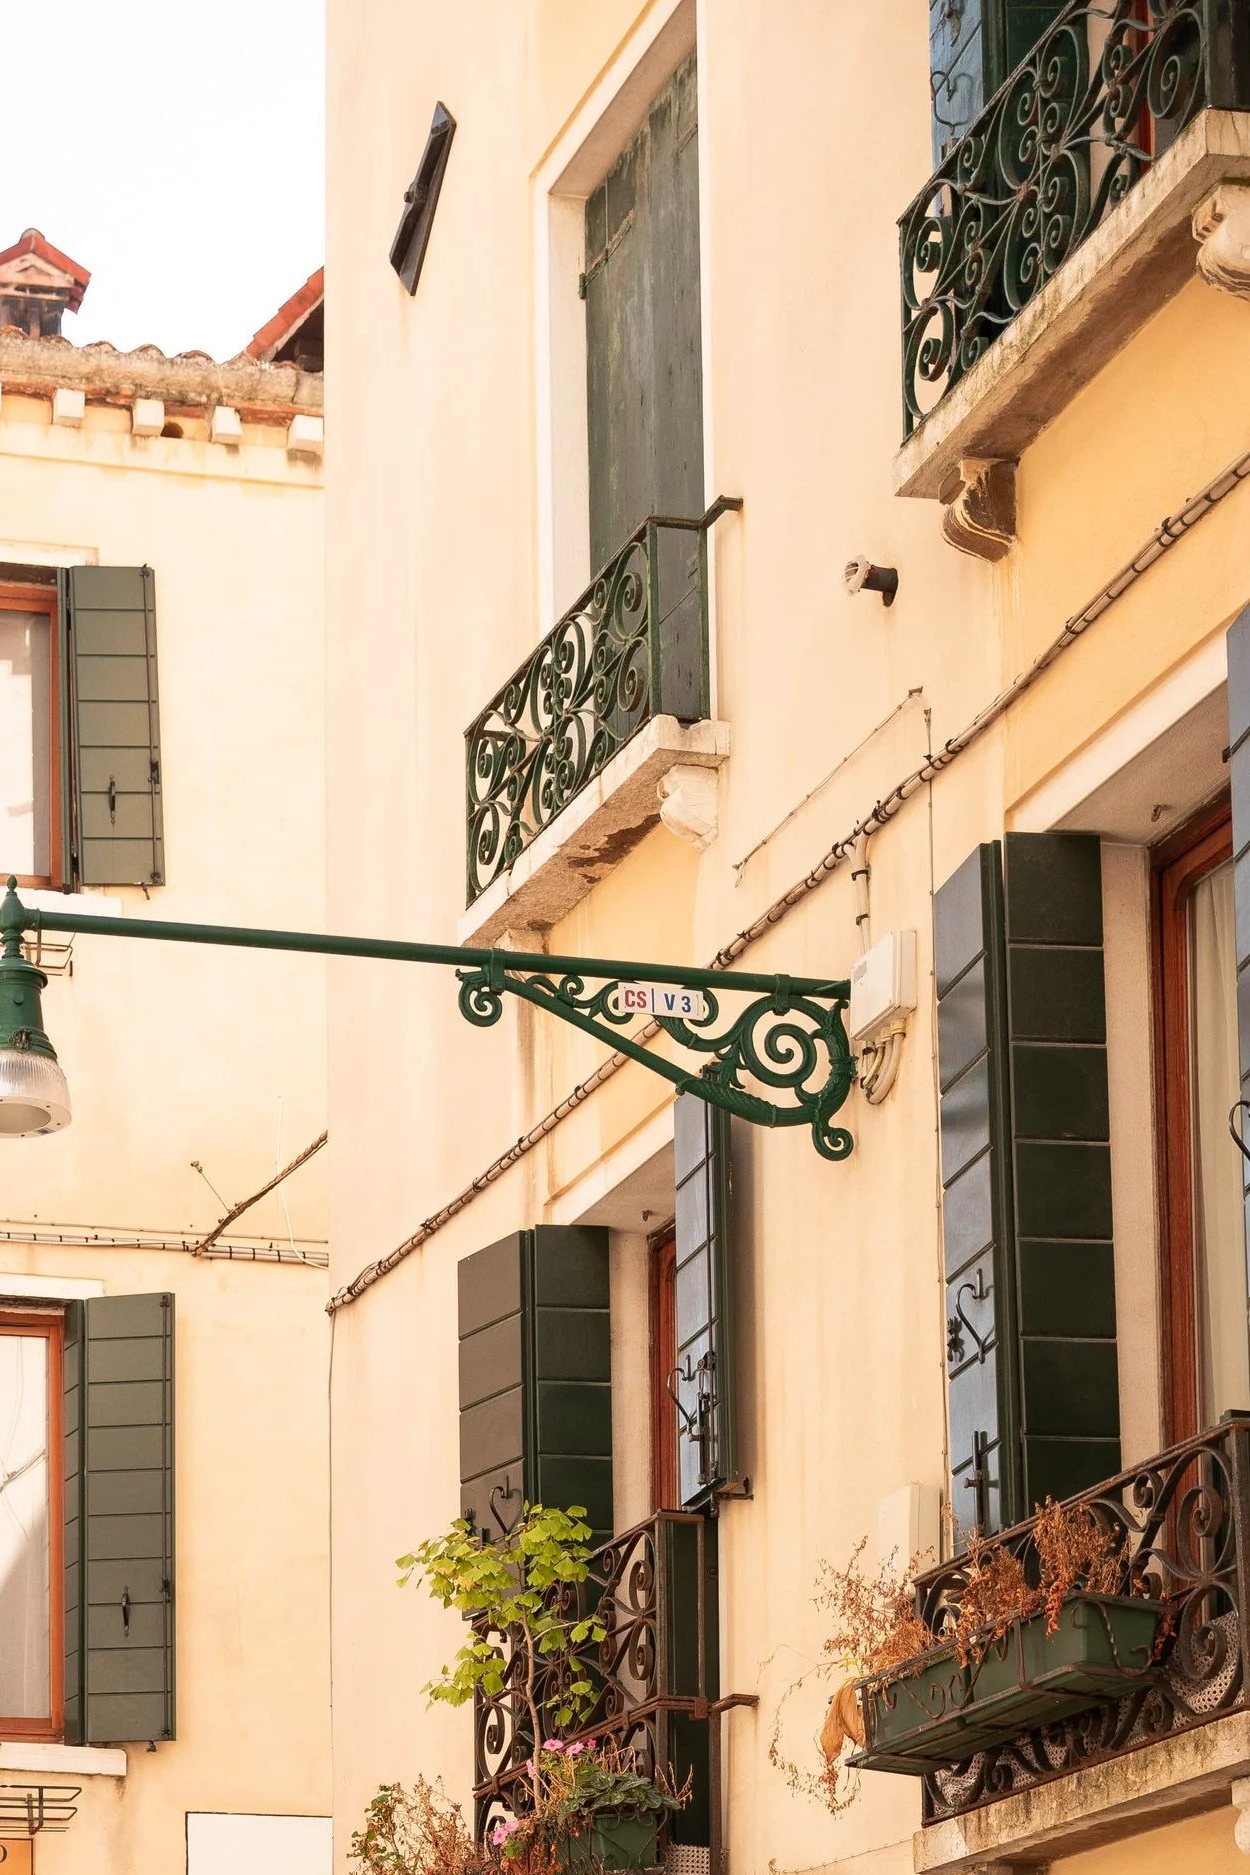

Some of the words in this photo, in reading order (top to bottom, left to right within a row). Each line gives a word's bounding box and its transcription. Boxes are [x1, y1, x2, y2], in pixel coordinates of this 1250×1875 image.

[624, 989, 647, 1009] CS
[664, 993, 675, 1011] V
[681, 995, 692, 1013] 3
